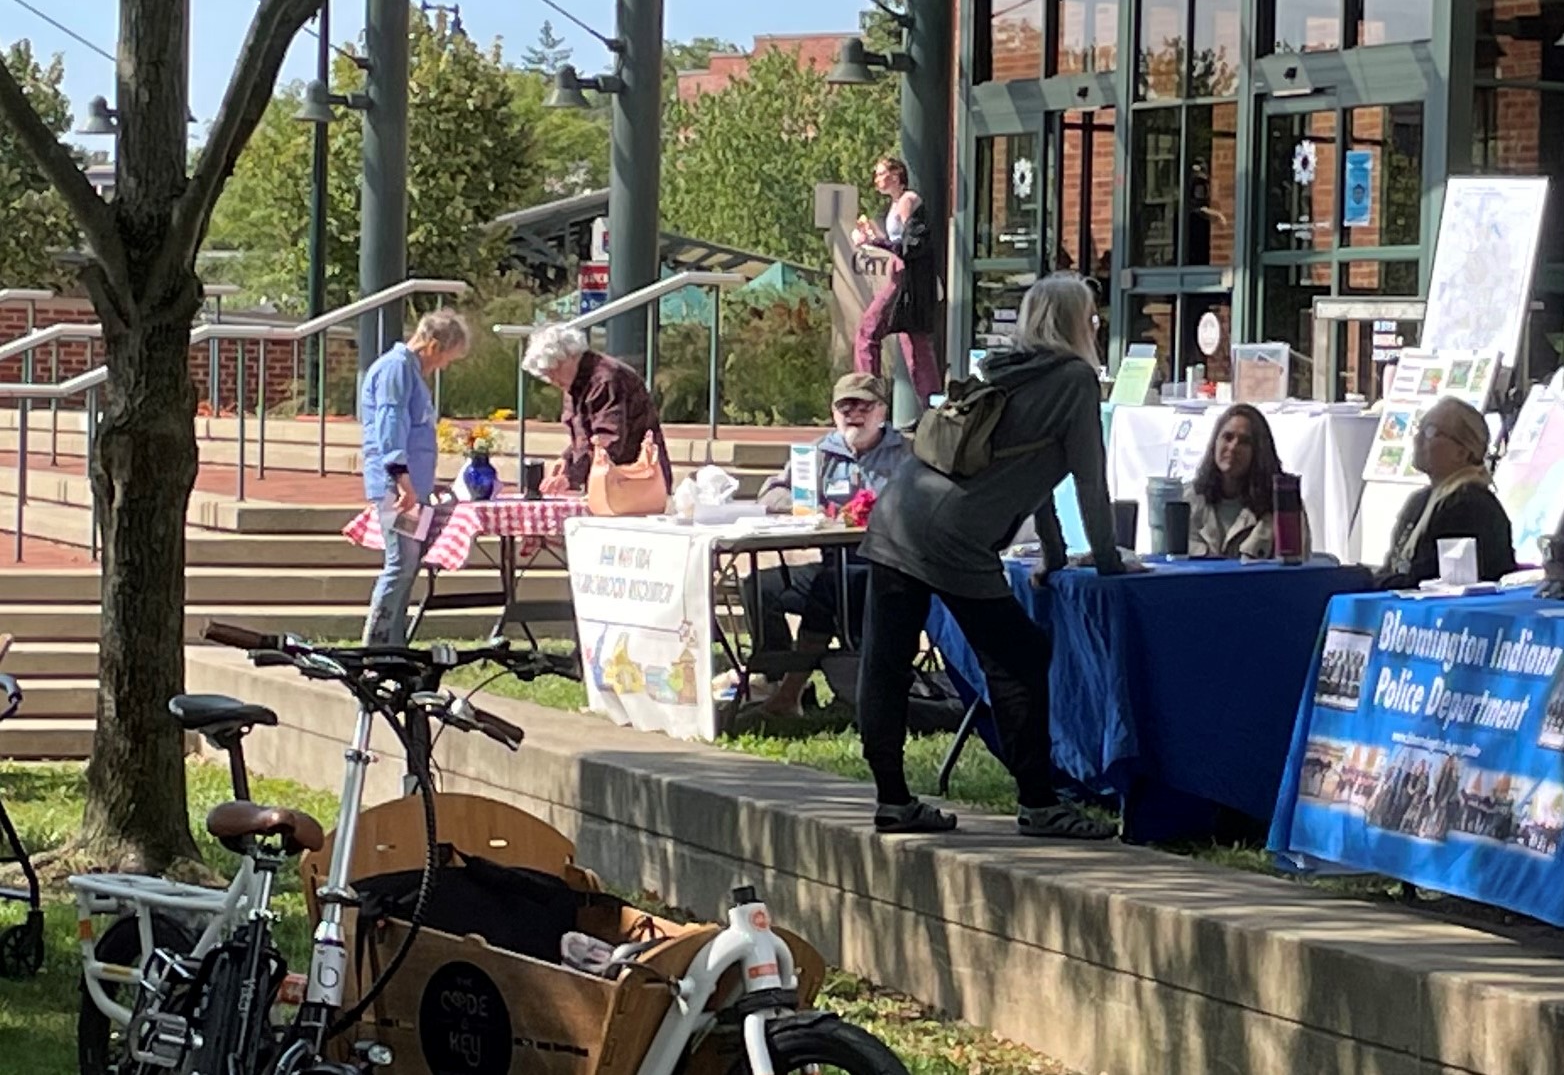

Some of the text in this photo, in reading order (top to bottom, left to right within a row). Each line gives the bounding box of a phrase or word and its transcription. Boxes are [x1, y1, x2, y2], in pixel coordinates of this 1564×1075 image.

[1378, 610, 1563, 676] Bloomington Indiana
[1374, 667, 1530, 730] Police Department
